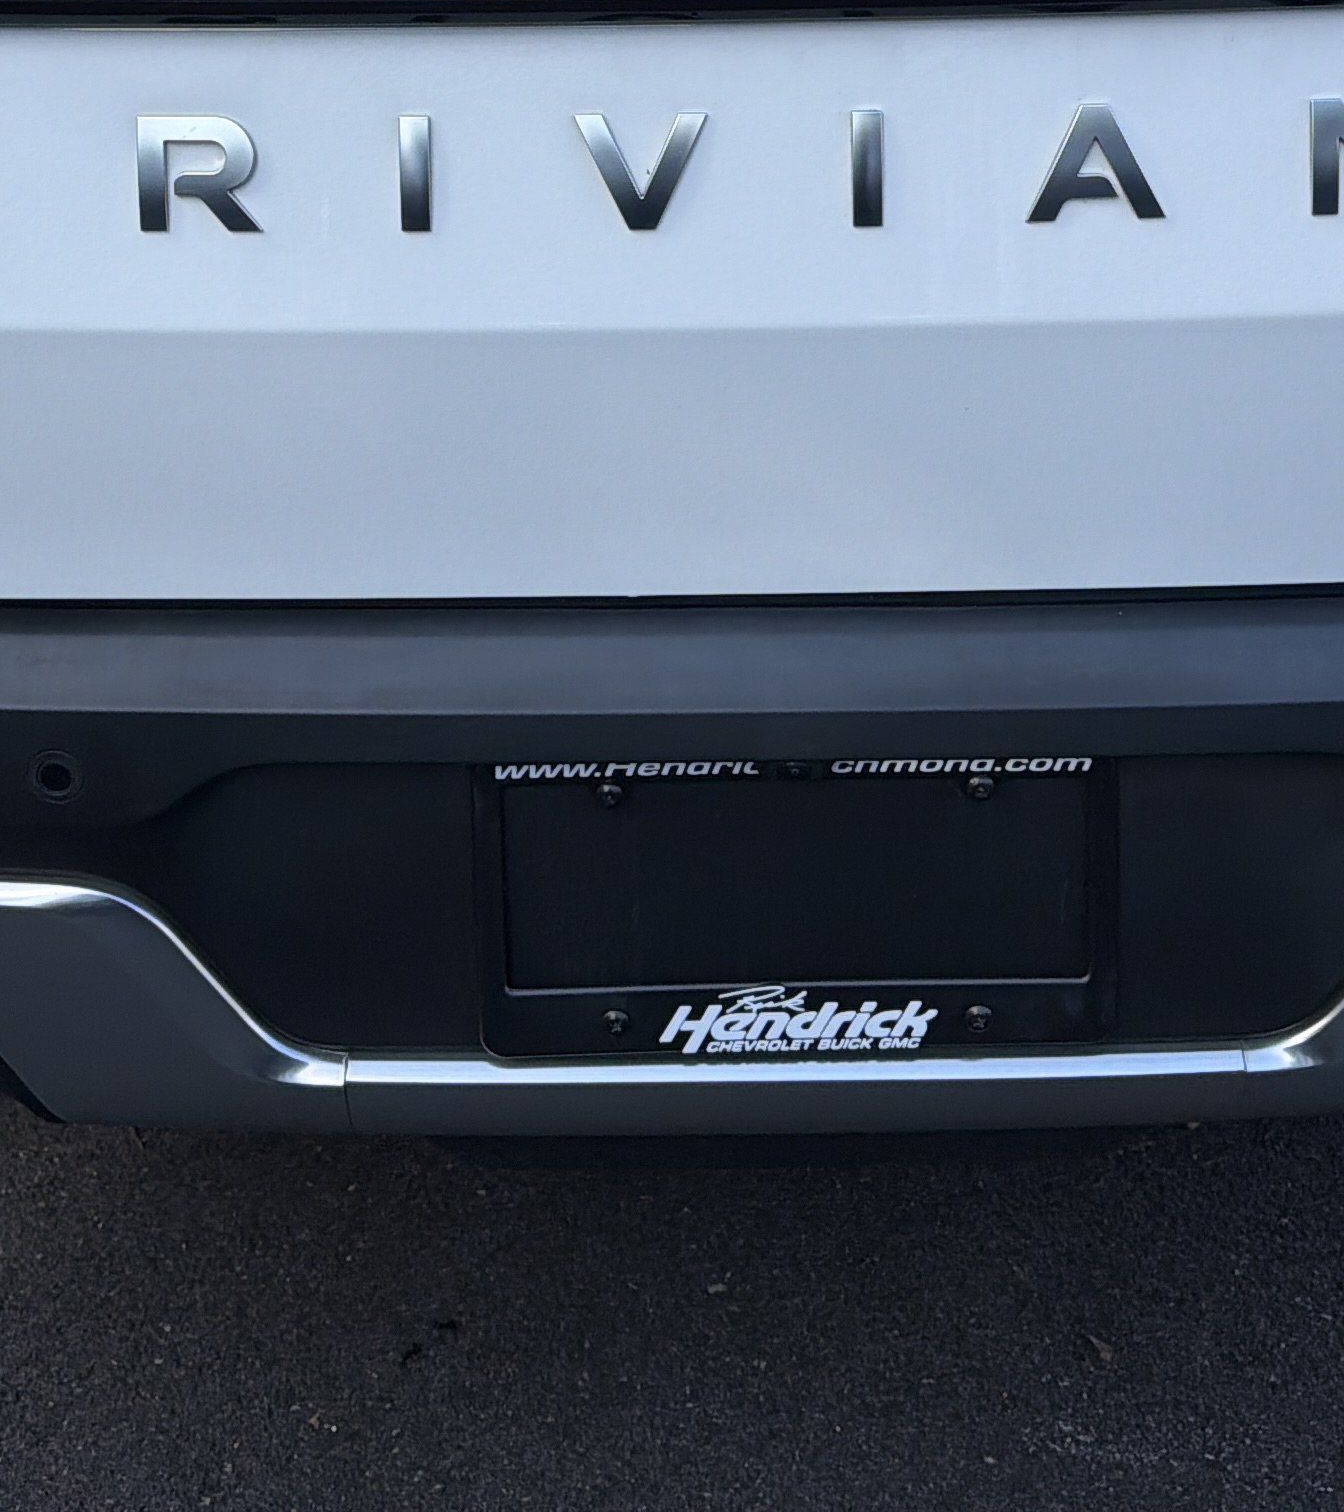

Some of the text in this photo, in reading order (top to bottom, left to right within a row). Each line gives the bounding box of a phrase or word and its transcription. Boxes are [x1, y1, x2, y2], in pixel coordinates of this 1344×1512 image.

[659, 1000, 938, 1054] Hendrick
[706, 1037, 921, 1053] CHEVROLET BUICK GMC
